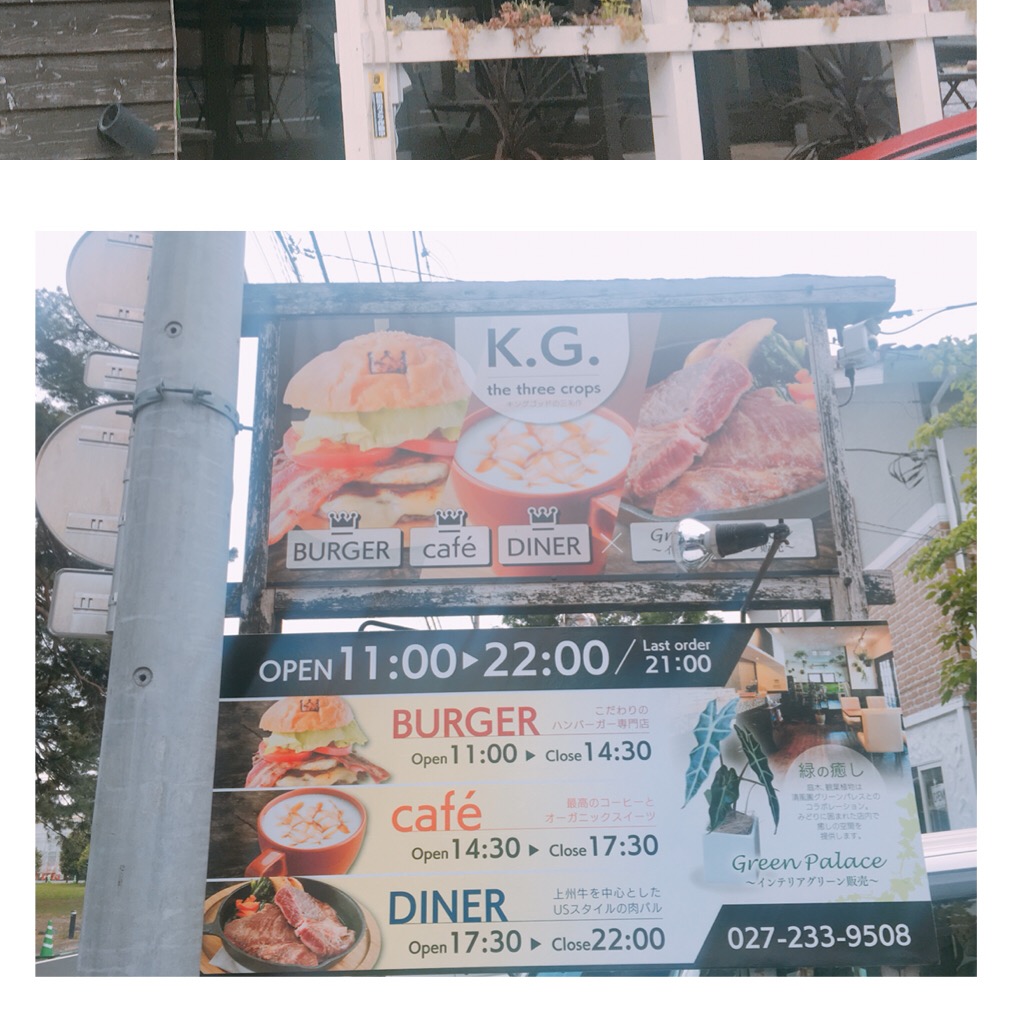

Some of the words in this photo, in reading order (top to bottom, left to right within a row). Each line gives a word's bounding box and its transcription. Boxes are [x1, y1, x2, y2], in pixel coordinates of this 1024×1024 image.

[487, 326, 600, 367] K.G.
[486, 383, 511, 396] the
[516, 383, 556, 395] three
[560, 384, 601, 397] crops
[294, 541, 391, 561] BURGER
[423, 536, 477, 559] café
[508, 536, 581, 557] DINER
[643, 640, 670, 651] Last
[675, 639, 711, 651] order
[259, 659, 333, 682] OPEN
[340, 643, 457, 680] 11:00
[484, 640, 610, 676] 22:00
[645, 654, 712, 673] 21:00
[595, 705, 649, 716] こだわりの
[393, 707, 540, 739] BURGER
[552, 718, 650, 730] ハンバーガー専門店
[411, 752, 447, 768] Open
[451, 743, 517, 764] 11:00
[545, 749, 582, 762] Close
[584, 740, 652, 761] 14:30
[798, 762, 864, 779] 緑の癒し
[391, 790, 482, 833] café
[566, 797, 655, 809] 最高のコーヒーと
[545, 812, 656, 824] オーガニックスイーツ
[411, 847, 448, 863] Open
[452, 837, 521, 860] 14:30
[549, 844, 587, 857] Close
[589, 834, 659, 856] 17:30
[732, 854, 802, 873] Green
[804, 851, 888, 872] Palace
[553, 887, 662, 900] 上州牛を中心とした
[389, 888, 508, 925] DINER
[553, 902, 663, 916] USスタイルの肉バル
[408, 941, 447, 958] Open
[451, 929, 523, 953] 17:30
[551, 937, 591, 952] Close
[591, 927, 666, 951] 22:00
[727, 923, 912, 950] 027-233-9508
